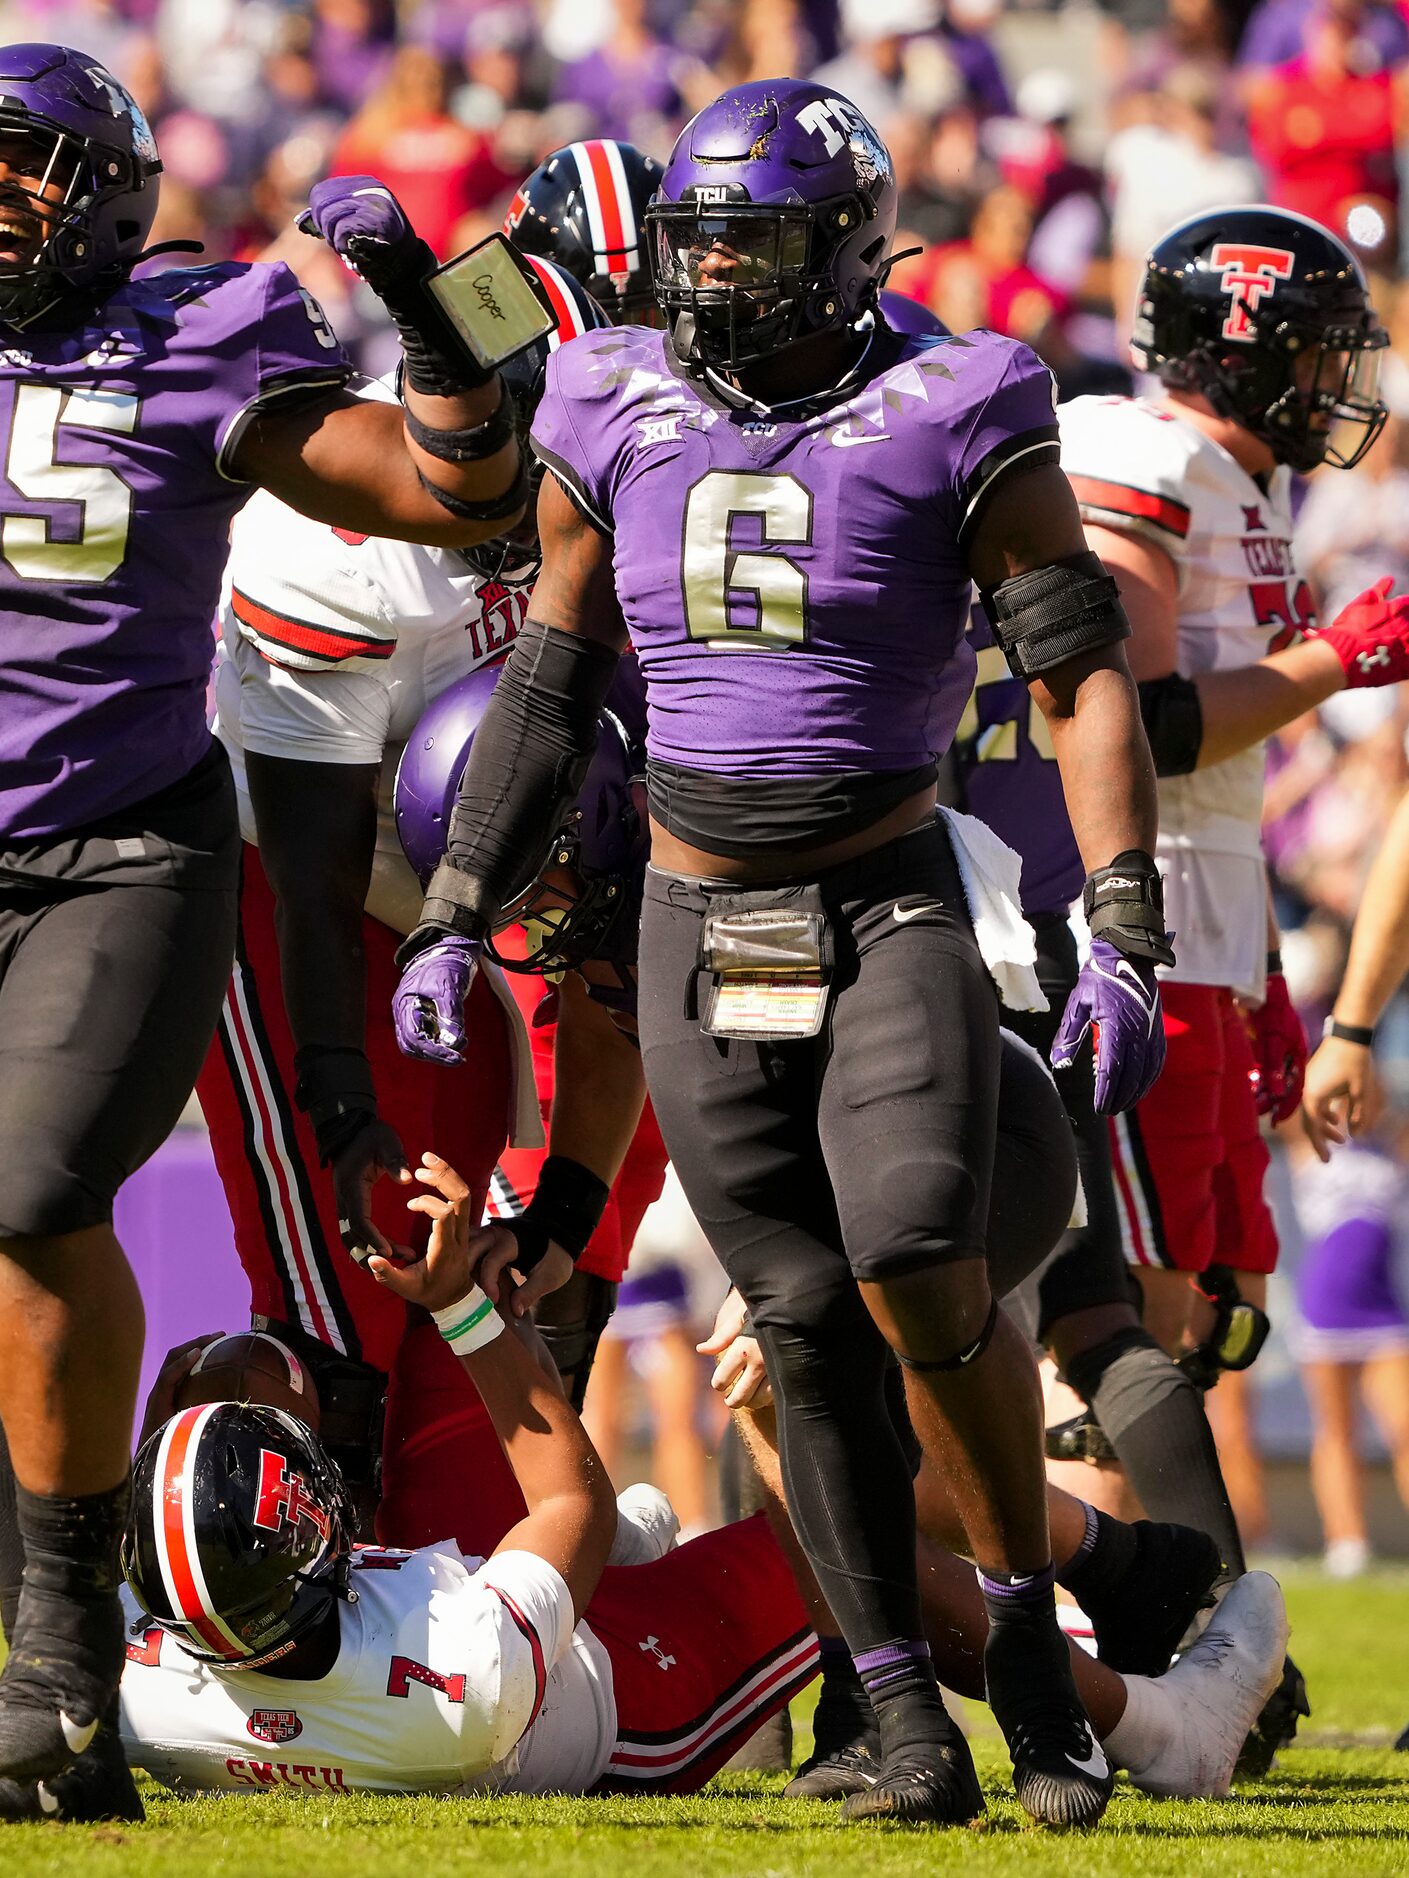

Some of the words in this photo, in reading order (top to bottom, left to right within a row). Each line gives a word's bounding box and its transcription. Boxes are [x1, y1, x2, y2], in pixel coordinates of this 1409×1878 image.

[694, 187, 727, 202] TCU
[472, 274, 506, 321] Cooper
[633, 414, 687, 451] XII
[742, 420, 777, 437] TCU
[681, 469, 814, 652] 6
[386, 1655, 467, 1703] 7
[260, 1712, 276, 1721] TEXAS
[277, 1714, 290, 1722] TECH
[226, 1758, 351, 1796] SMITH
